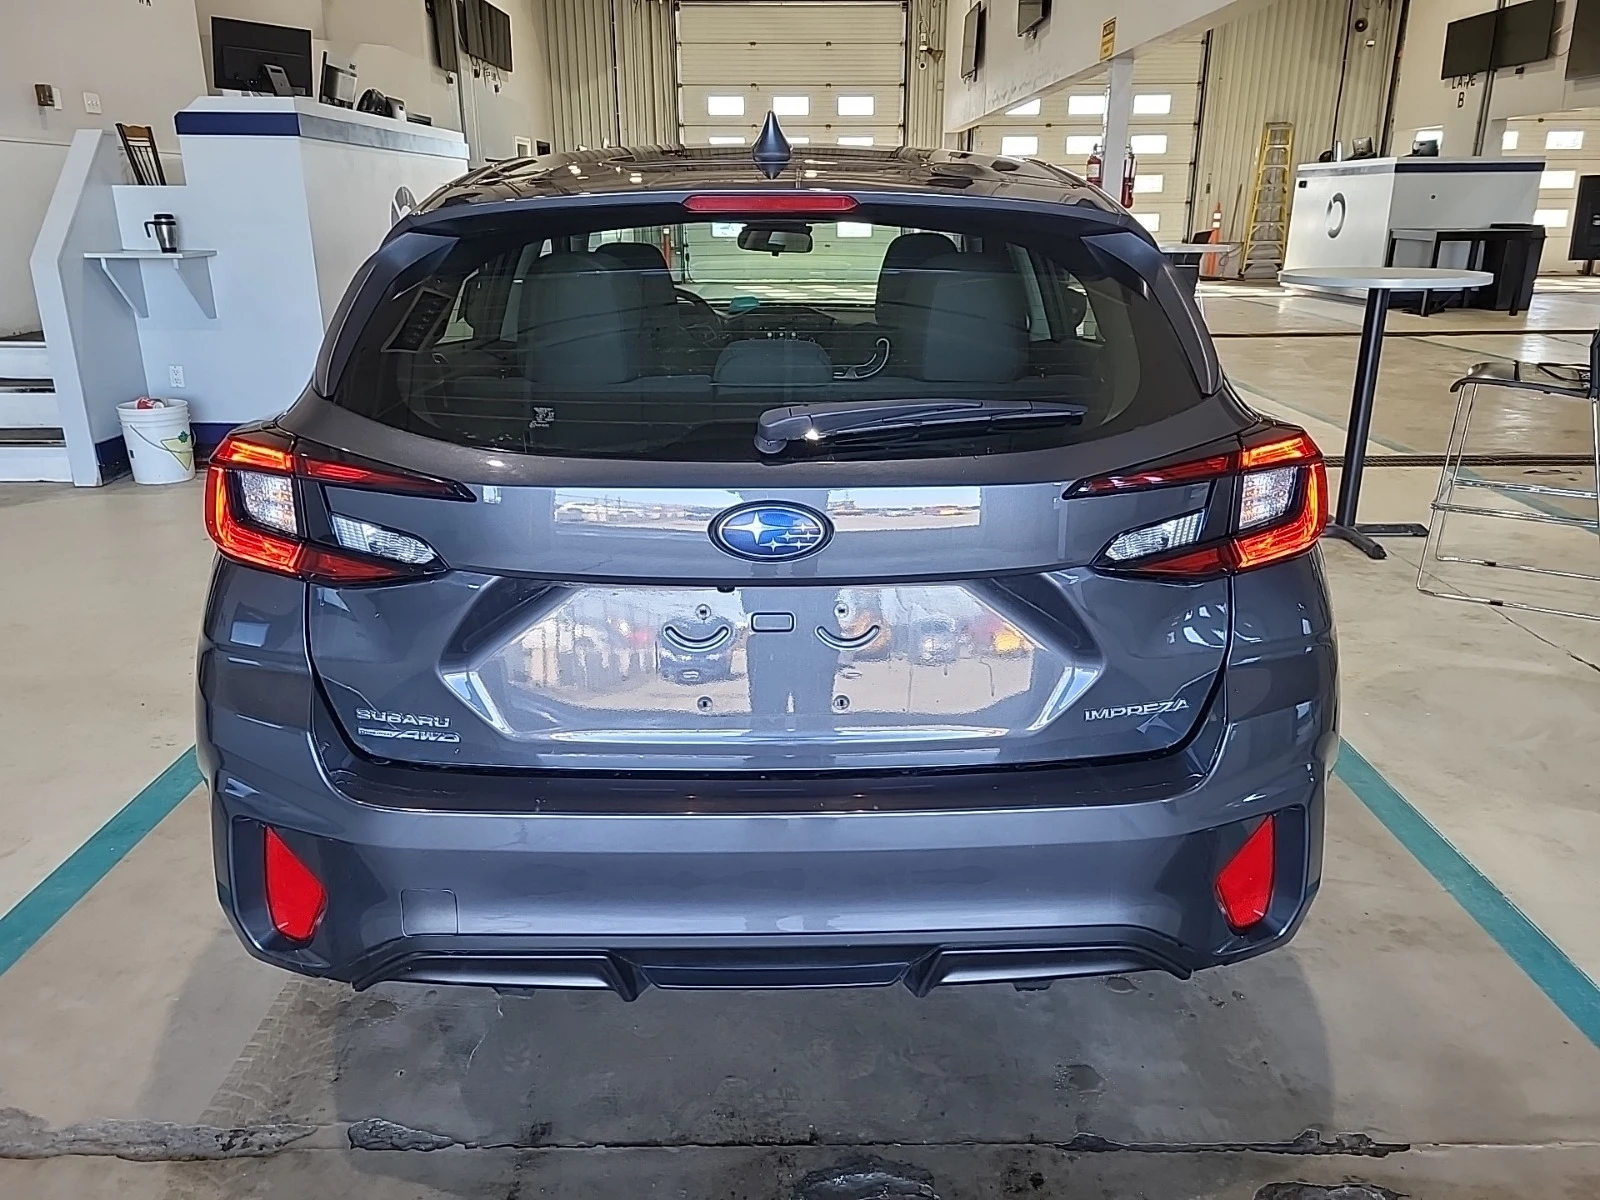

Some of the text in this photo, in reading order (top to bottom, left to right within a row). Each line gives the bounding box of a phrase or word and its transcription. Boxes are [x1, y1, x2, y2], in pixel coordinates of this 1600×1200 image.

[1457, 91, 1465, 109] B
[355, 708, 450, 728] SUBARU
[1084, 698, 1190, 721] IMPREZA
[396, 729, 461, 743] AWD
